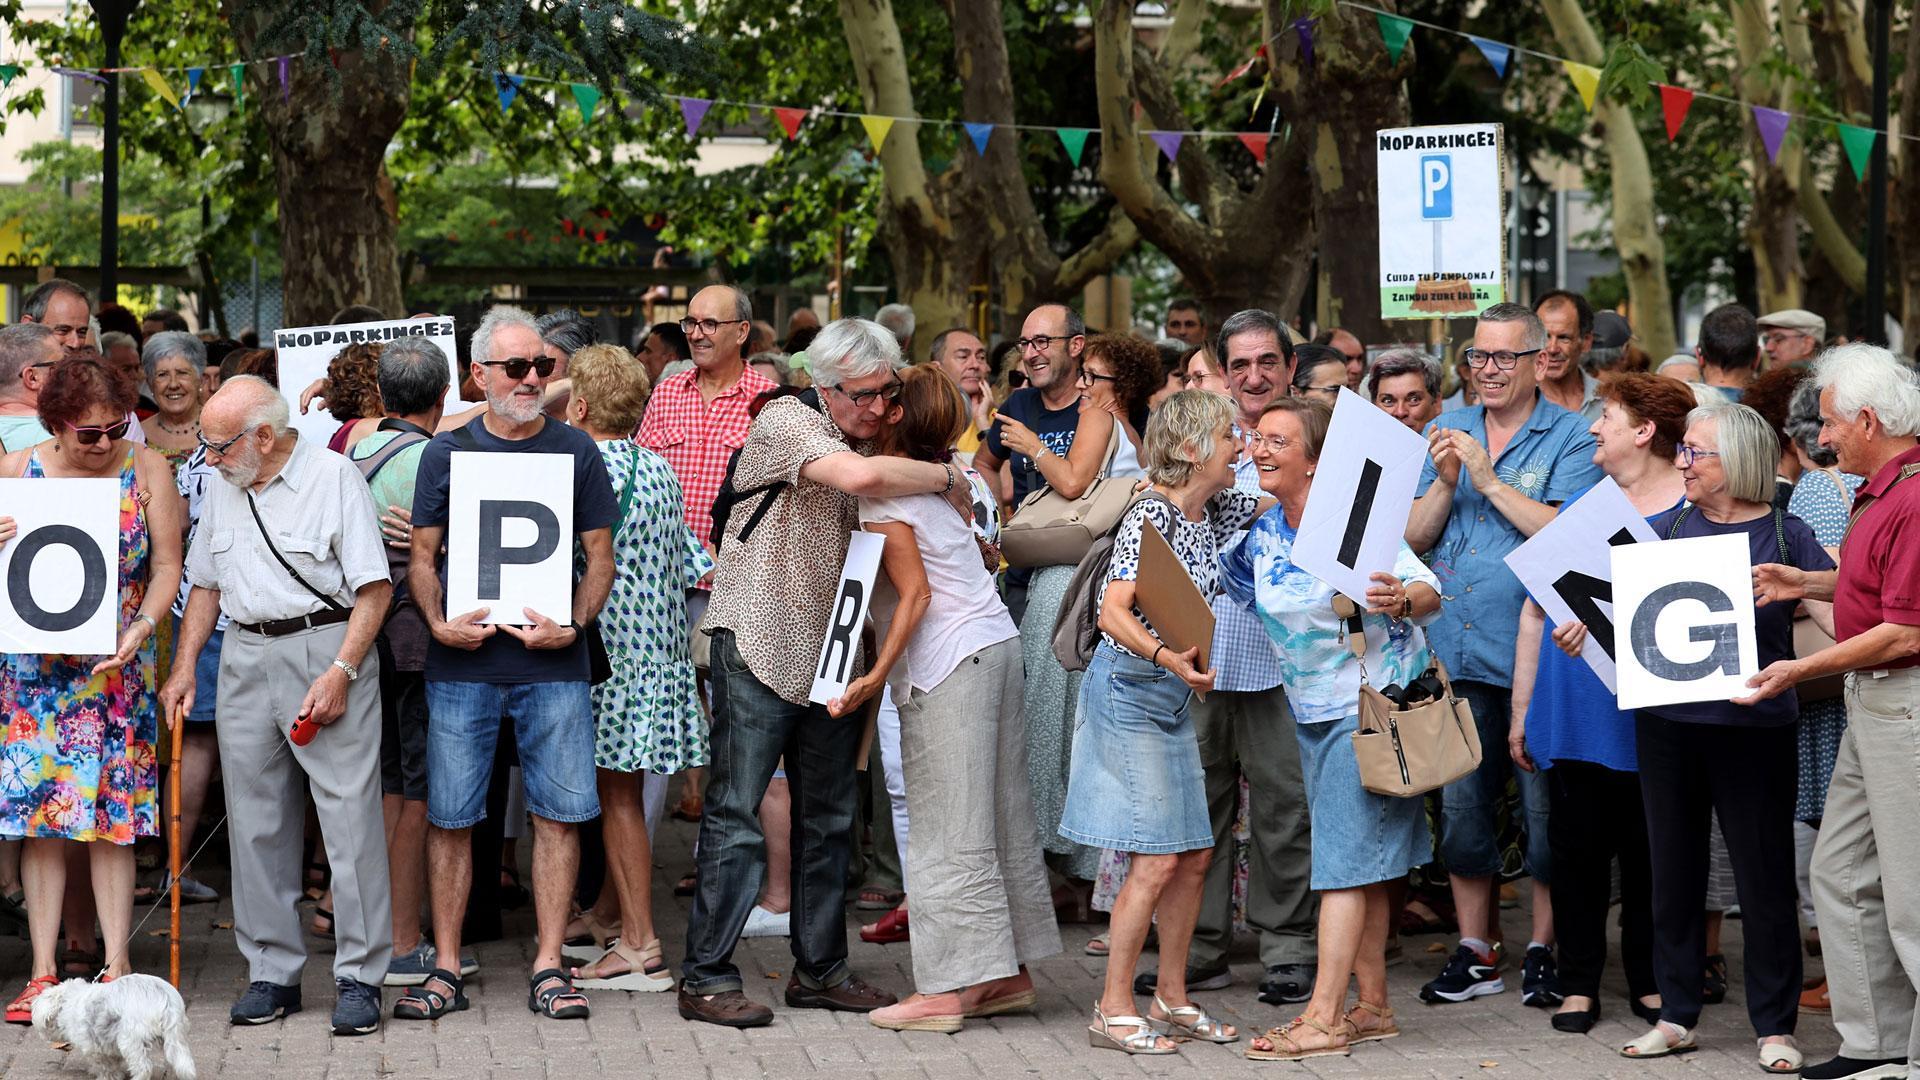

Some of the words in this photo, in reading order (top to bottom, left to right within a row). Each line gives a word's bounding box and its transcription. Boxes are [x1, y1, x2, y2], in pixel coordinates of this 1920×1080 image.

[1423, 160, 1449, 207] P
[7, 524, 107, 632] O
[478, 499, 561, 600] P
[819, 578, 864, 684] R
[1630, 580, 1741, 682] G
